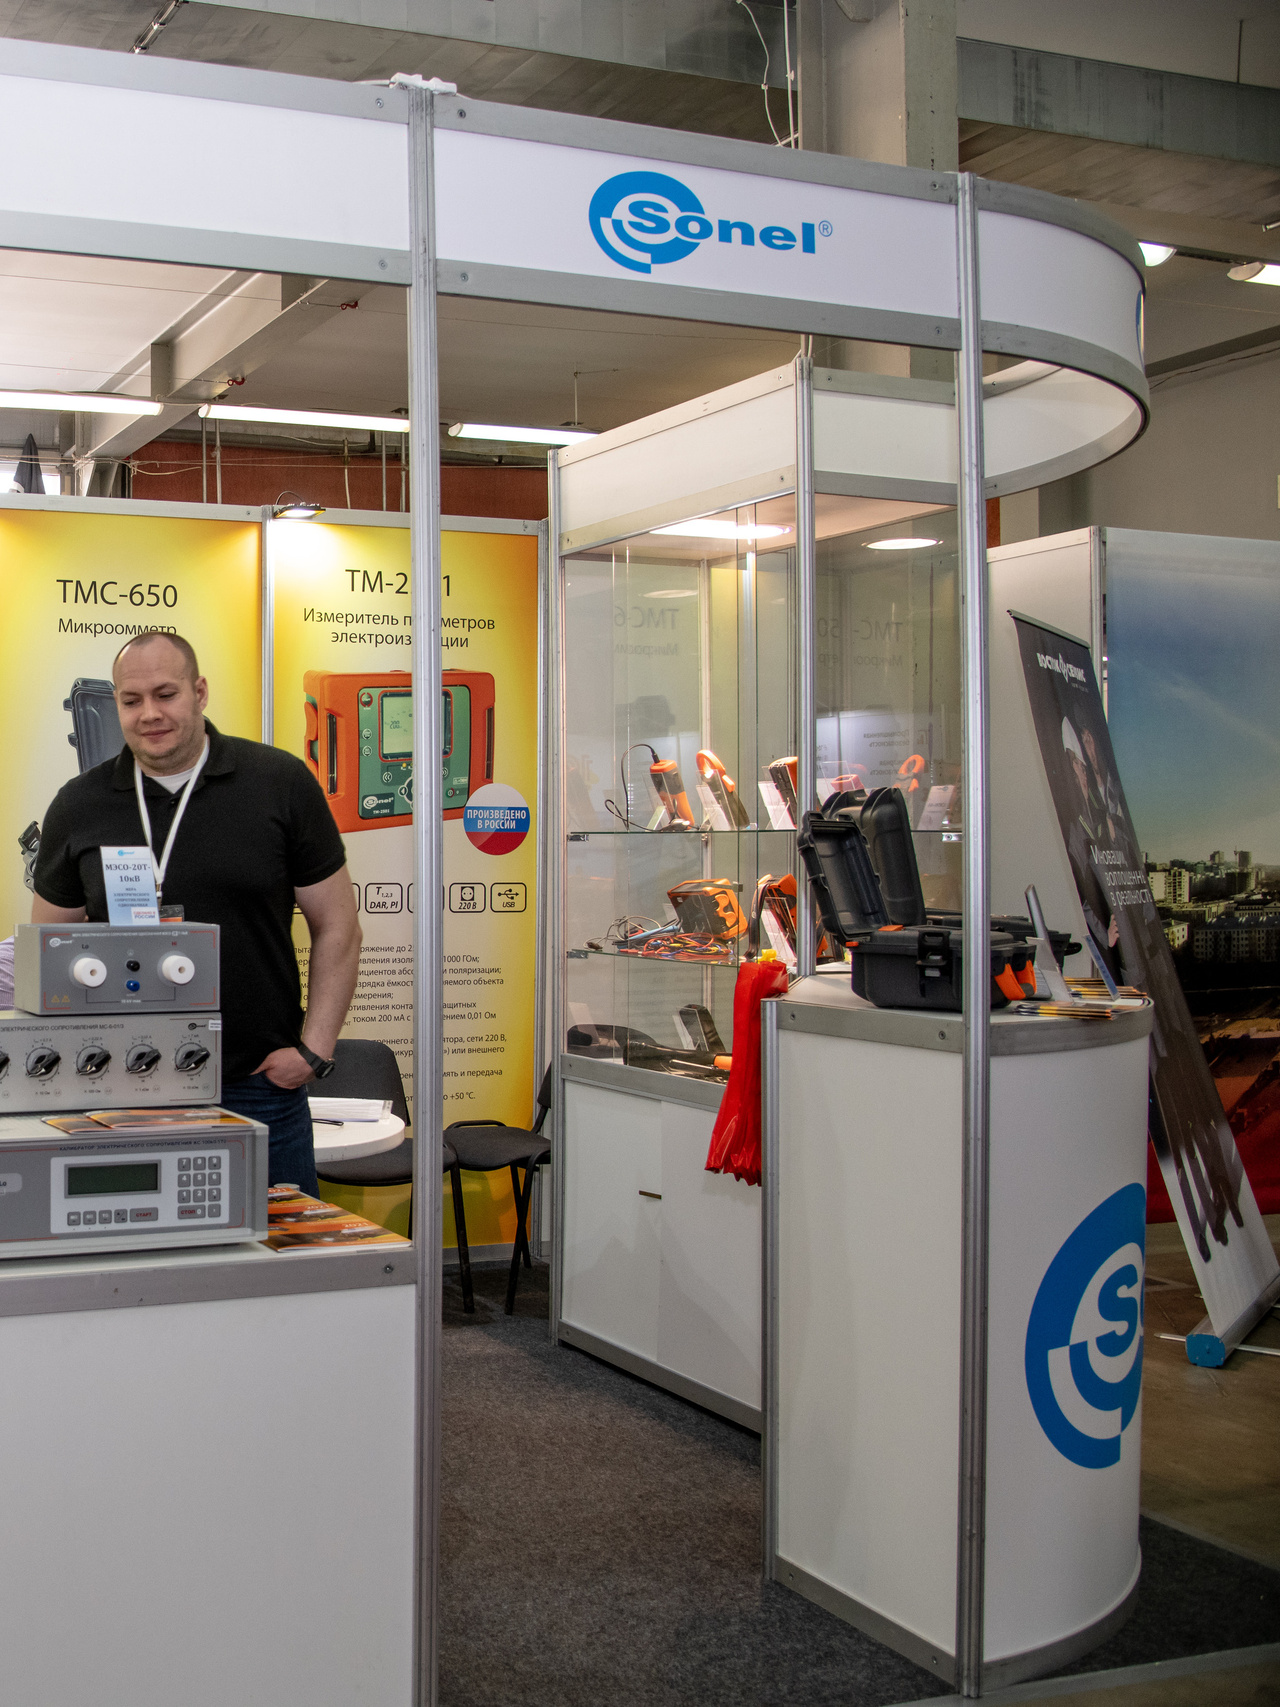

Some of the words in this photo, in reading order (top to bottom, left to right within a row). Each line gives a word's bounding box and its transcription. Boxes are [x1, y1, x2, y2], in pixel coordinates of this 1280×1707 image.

[345, 569, 451, 597] TM-21
[303, 607, 399, 627] Измеритель
[403, 615, 496, 633] пметров
[331, 630, 469, 650] электроизции
[467, 808, 526, 820] ПРОИЗВЕДЕНО
[477, 820, 483, 829] В
[484, 820, 517, 830] РОССИИ
[458, 902, 470, 910] 220
[473, 977, 504, 986] объекта
[352, 1015, 376, 1023] током
[378, 1014, 392, 1022] 200
[393, 1014, 405, 1022] мА
[467, 1011, 482, 1020] 0,01
[484, 1011, 496, 1019] Ом
[485, 1034, 498, 1042] 220
[468, 1046, 505, 1054] внешнего
[466, 1069, 503, 1078] передача
